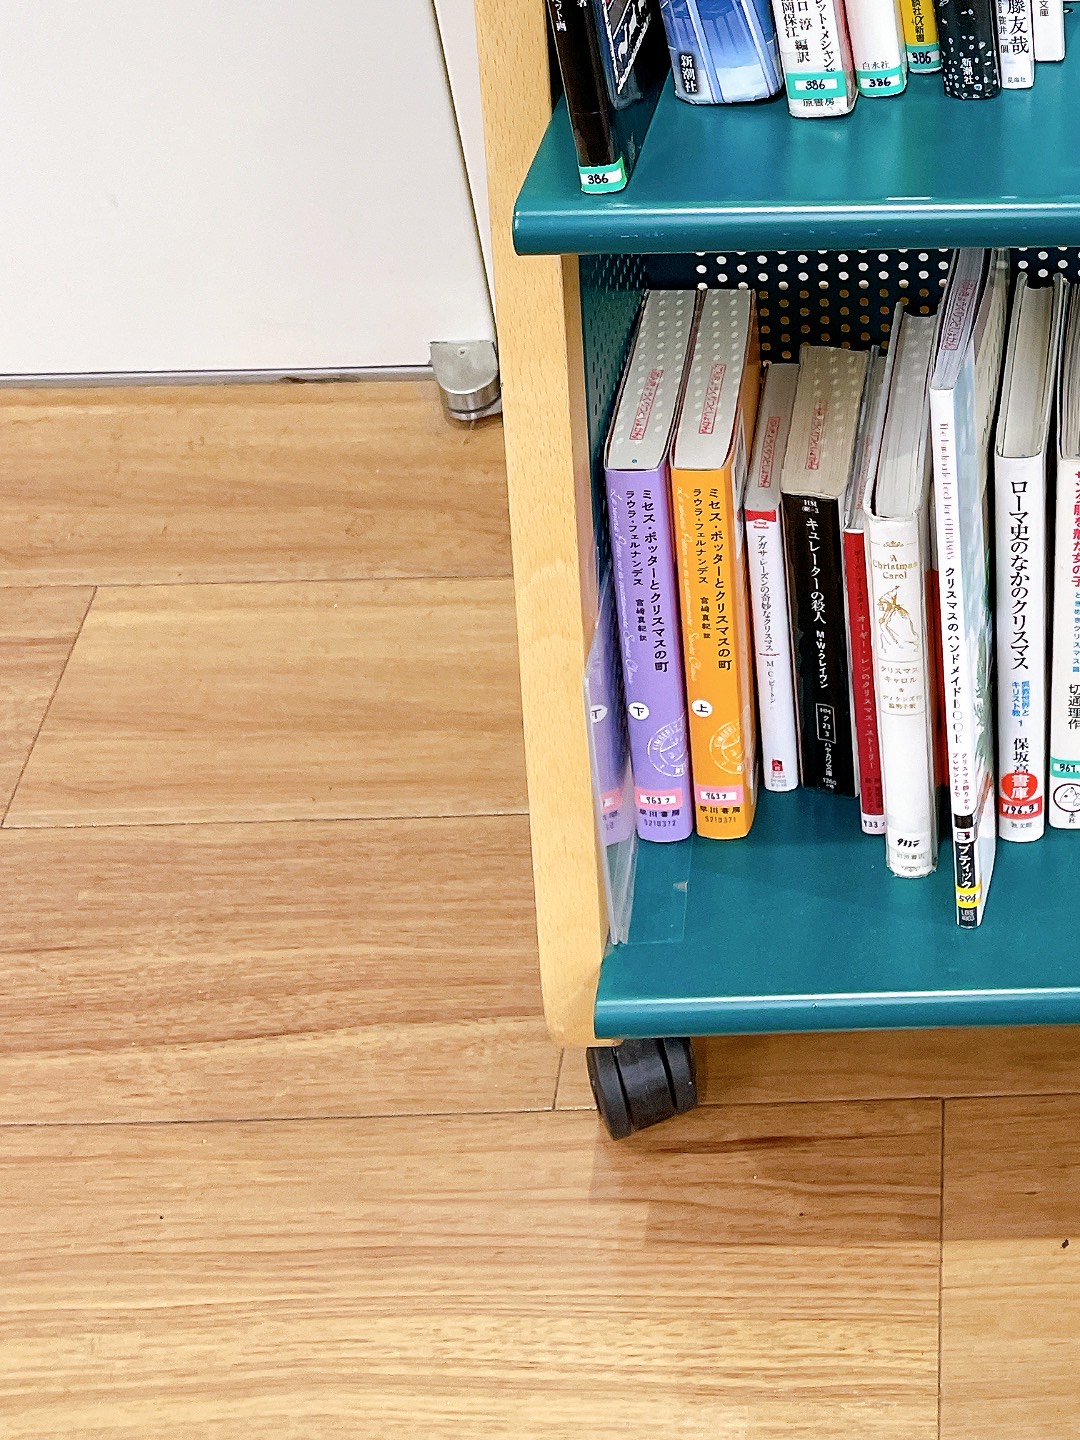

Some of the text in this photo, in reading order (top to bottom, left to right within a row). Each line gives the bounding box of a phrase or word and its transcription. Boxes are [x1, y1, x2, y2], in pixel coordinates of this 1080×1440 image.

[911, 51, 932, 65] 386
[960, 57, 975, 85] 新潮社
[680, 53, 698, 93] 新潮社
[805, 79, 826, 91] 386
[868, 78, 892, 88] 386
[587, 172, 609, 186] 386
[625, 490, 644, 587] ラウラ・フェルナンデス
[692, 489, 709, 584] ラウラ・フェルナンデス
[805, 517, 827, 625] キュレーターの殺人
[872, 559, 919, 571] Christmas
[889, 554, 898, 562] A
[641, 489, 669, 673] ミセス・ポッターとクリスマスの町
[708, 489, 733, 672] ミセス・ポッターとクリスマスの町
[882, 571, 908, 579] Carol
[1009, 480, 1030, 671] ローマ史のなかのクリスマス
[632, 706, 645, 717] 下
[695, 703, 709, 713] 上
[1011, 774, 1030, 800] 書庫
[958, 844, 973, 889] ブティック
